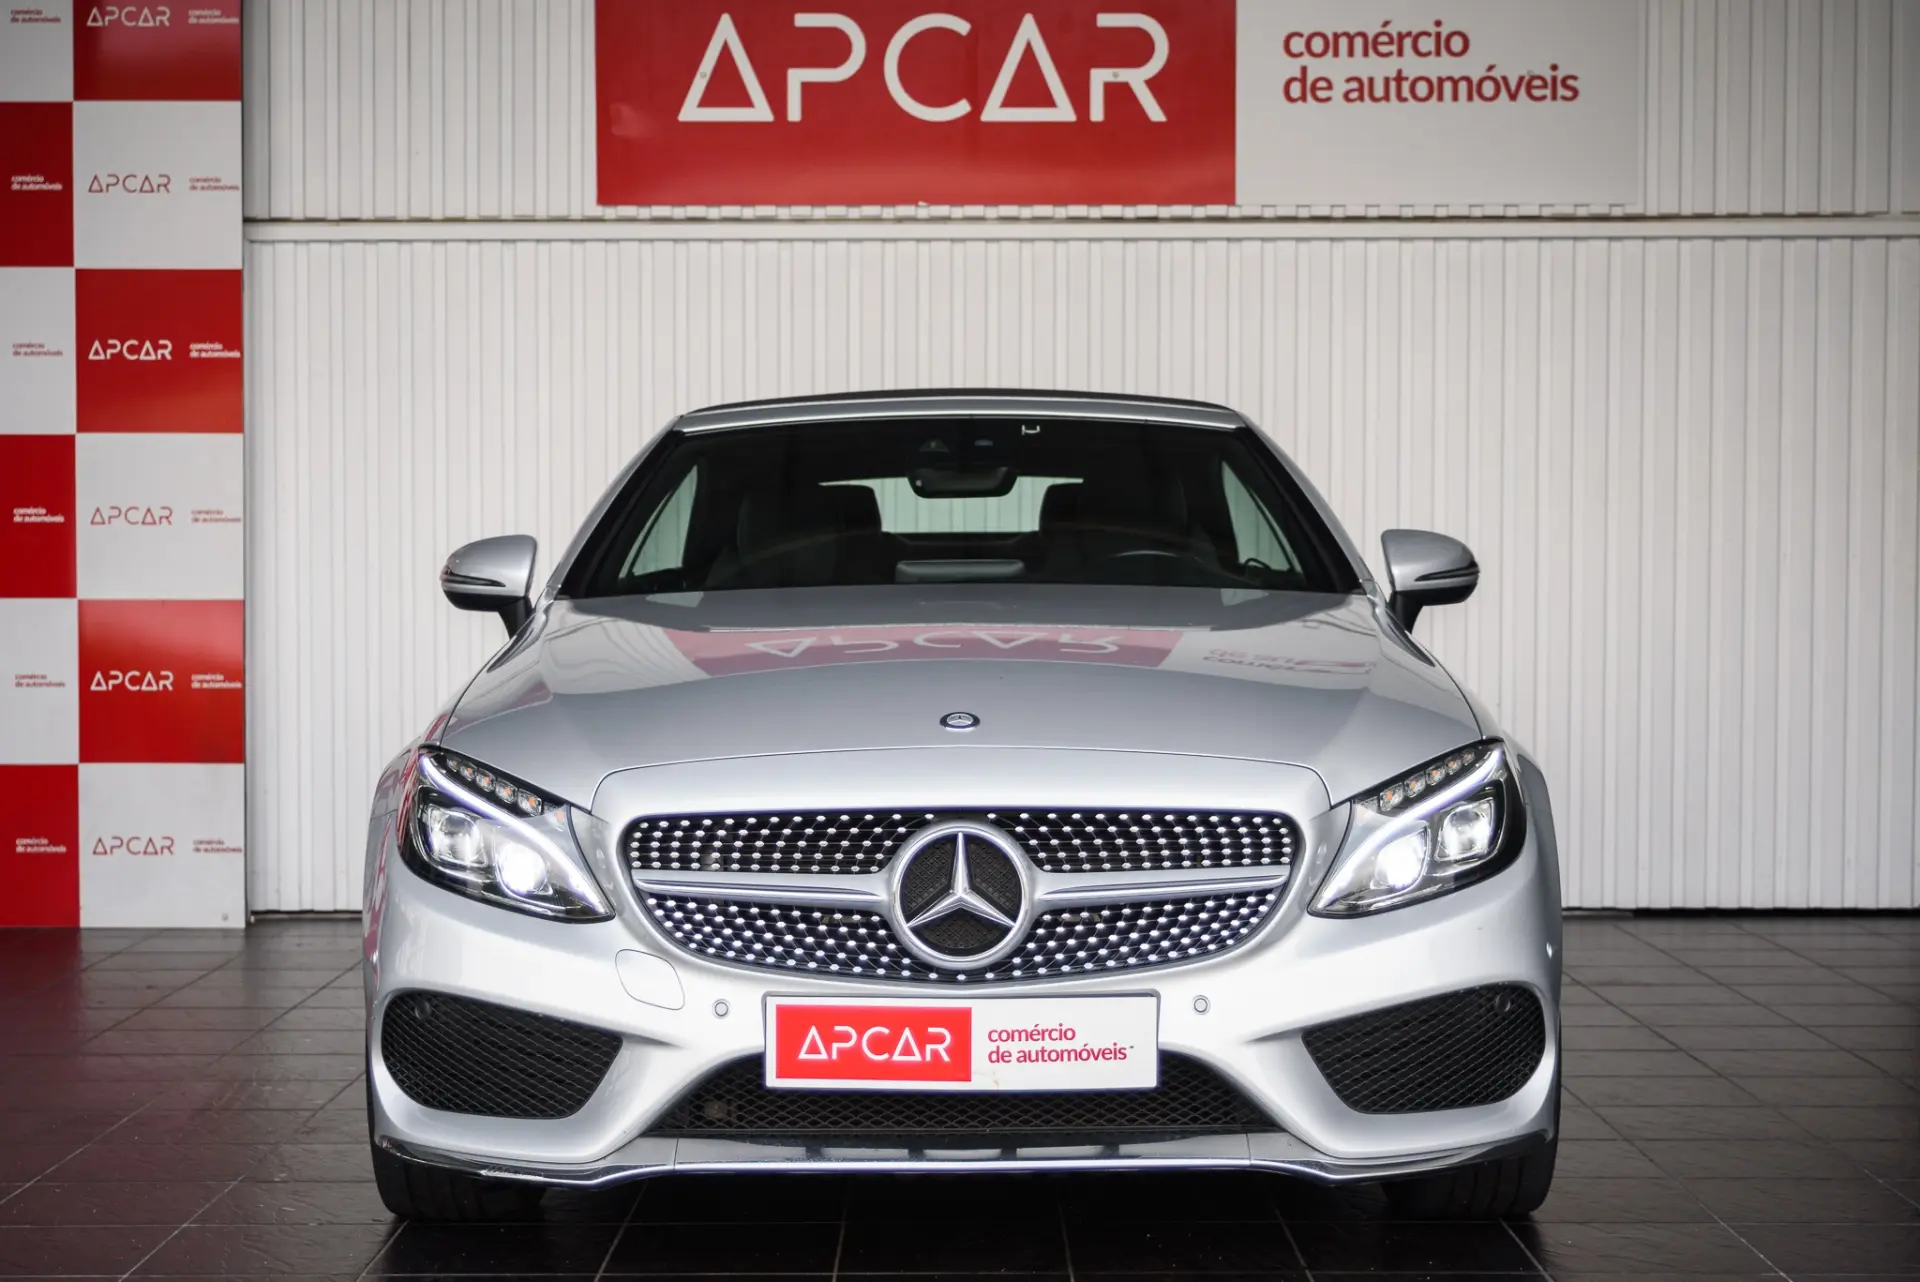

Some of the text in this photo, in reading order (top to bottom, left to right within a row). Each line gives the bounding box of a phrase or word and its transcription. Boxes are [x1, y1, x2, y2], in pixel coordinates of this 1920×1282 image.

[86, 6, 170, 27] APCAR
[1283, 19, 1470, 58] comércio
[677, 13, 1169, 122] APCAR
[1283, 63, 1580, 103] de automóveis
[88, 174, 171, 193] APCAR
[88, 339, 172, 360] APCAR
[90, 506, 173, 525] APCAR
[90, 670, 174, 691] APCAR
[92, 836, 174, 855] APCAR
[988, 1023, 1076, 1042] comércio
[798, 1026, 952, 1062] APCAR
[988, 1042, 1127, 1064] de automóveis
